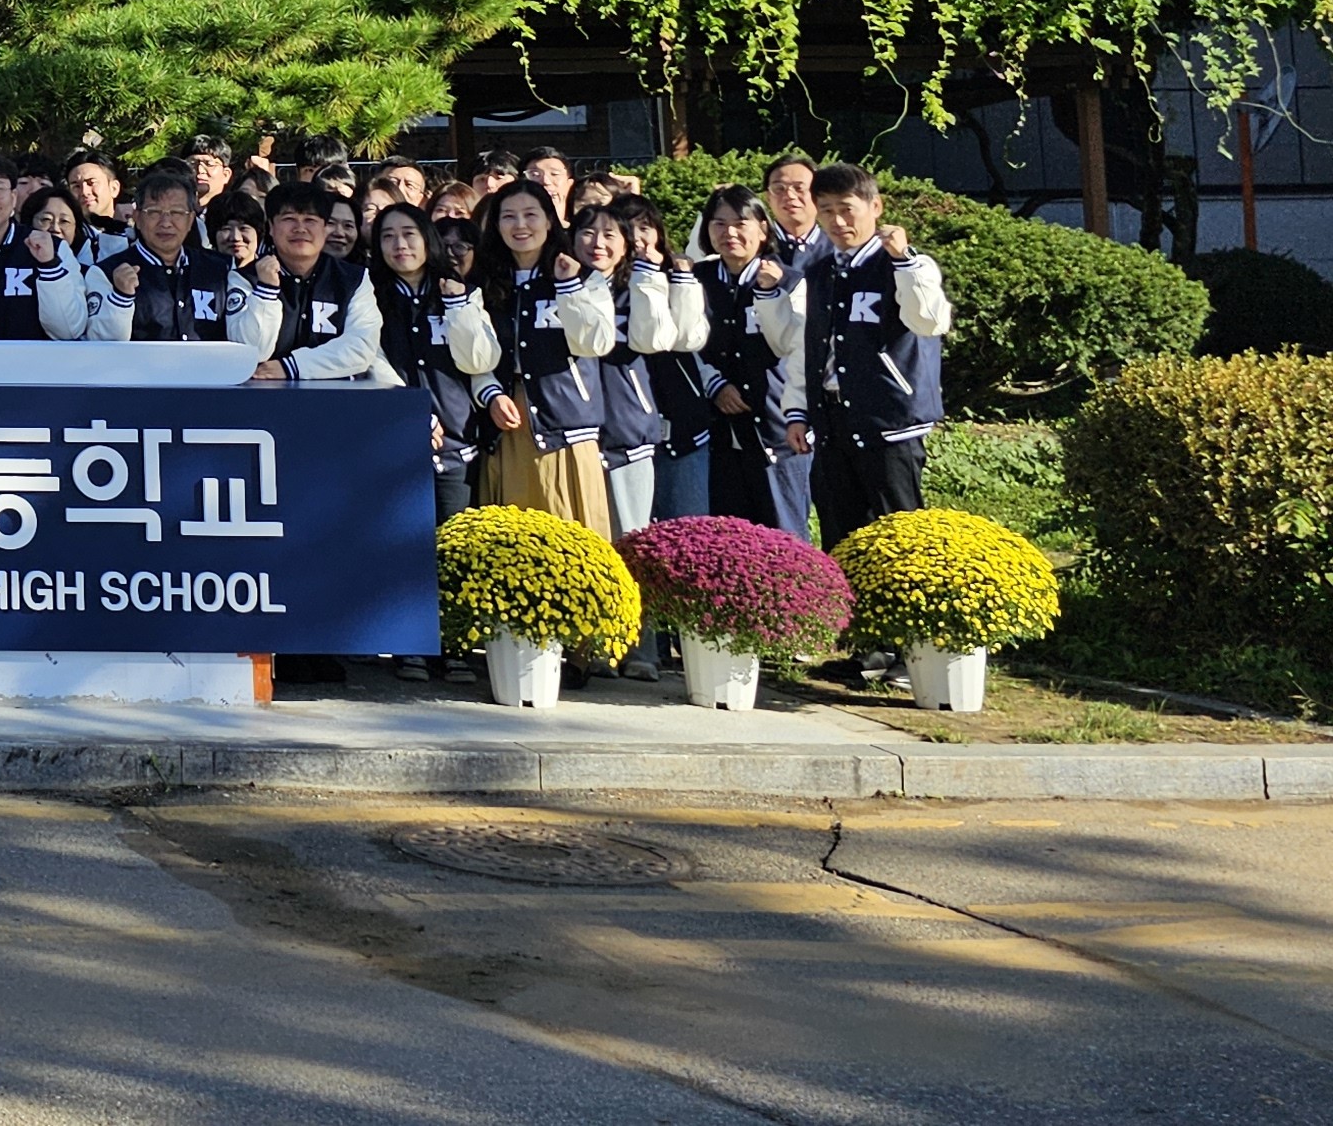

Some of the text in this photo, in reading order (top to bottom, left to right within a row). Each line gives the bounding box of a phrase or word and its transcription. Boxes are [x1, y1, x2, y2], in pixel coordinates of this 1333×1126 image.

[4, 267, 33, 296] K
[191, 288, 218, 321] K
[312, 300, 338, 334] K
[534, 299, 563, 328] K
[849, 291, 882, 324] K
[98, 571, 287, 615] SCHOOL
